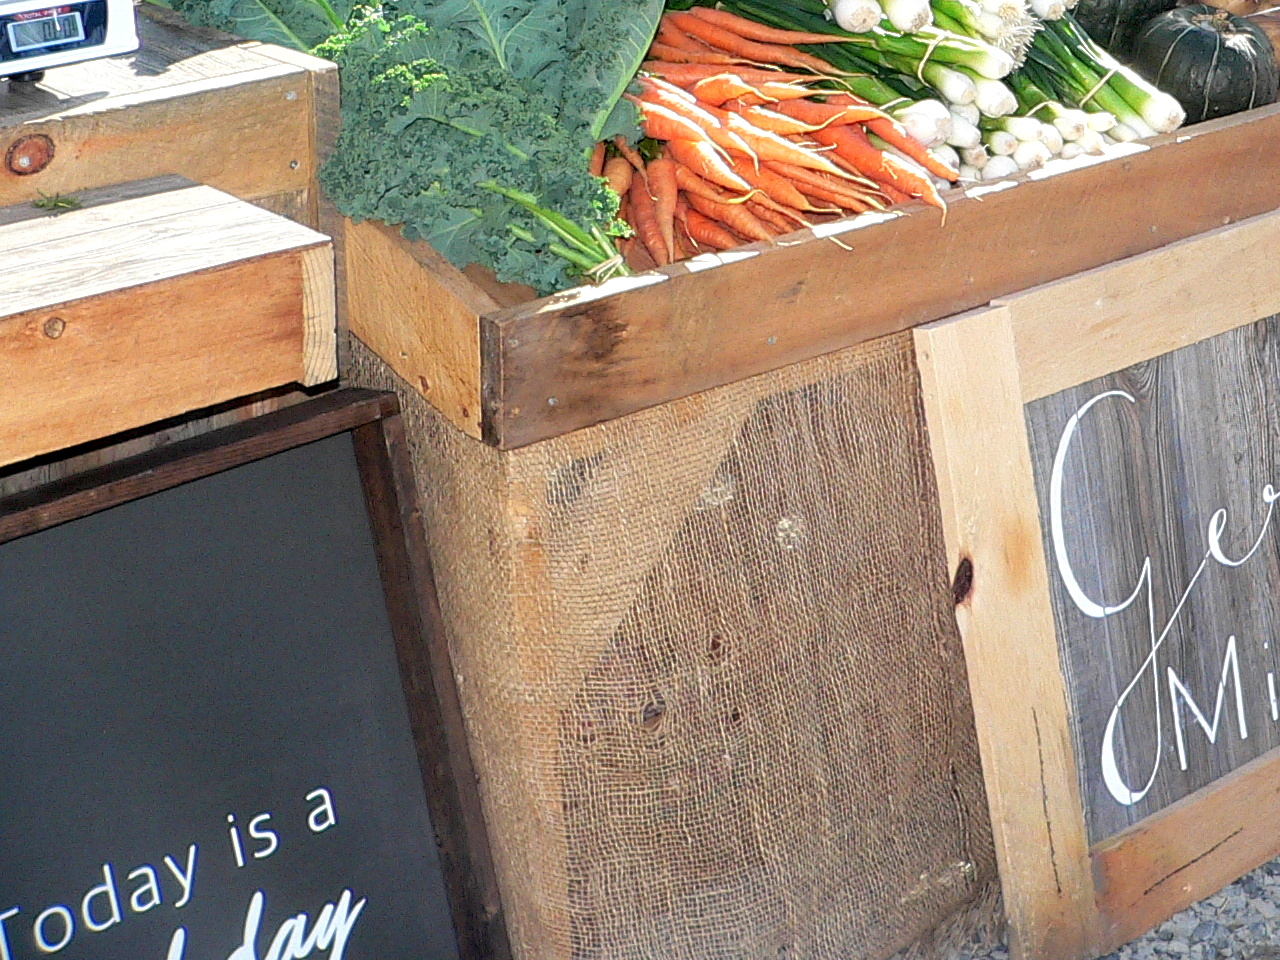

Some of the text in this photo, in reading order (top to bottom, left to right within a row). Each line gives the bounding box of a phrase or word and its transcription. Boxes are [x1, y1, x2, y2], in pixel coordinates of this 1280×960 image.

[0, 843, 197, 960] Today
[227, 812, 279, 868] is
[305, 787, 337, 833] a
